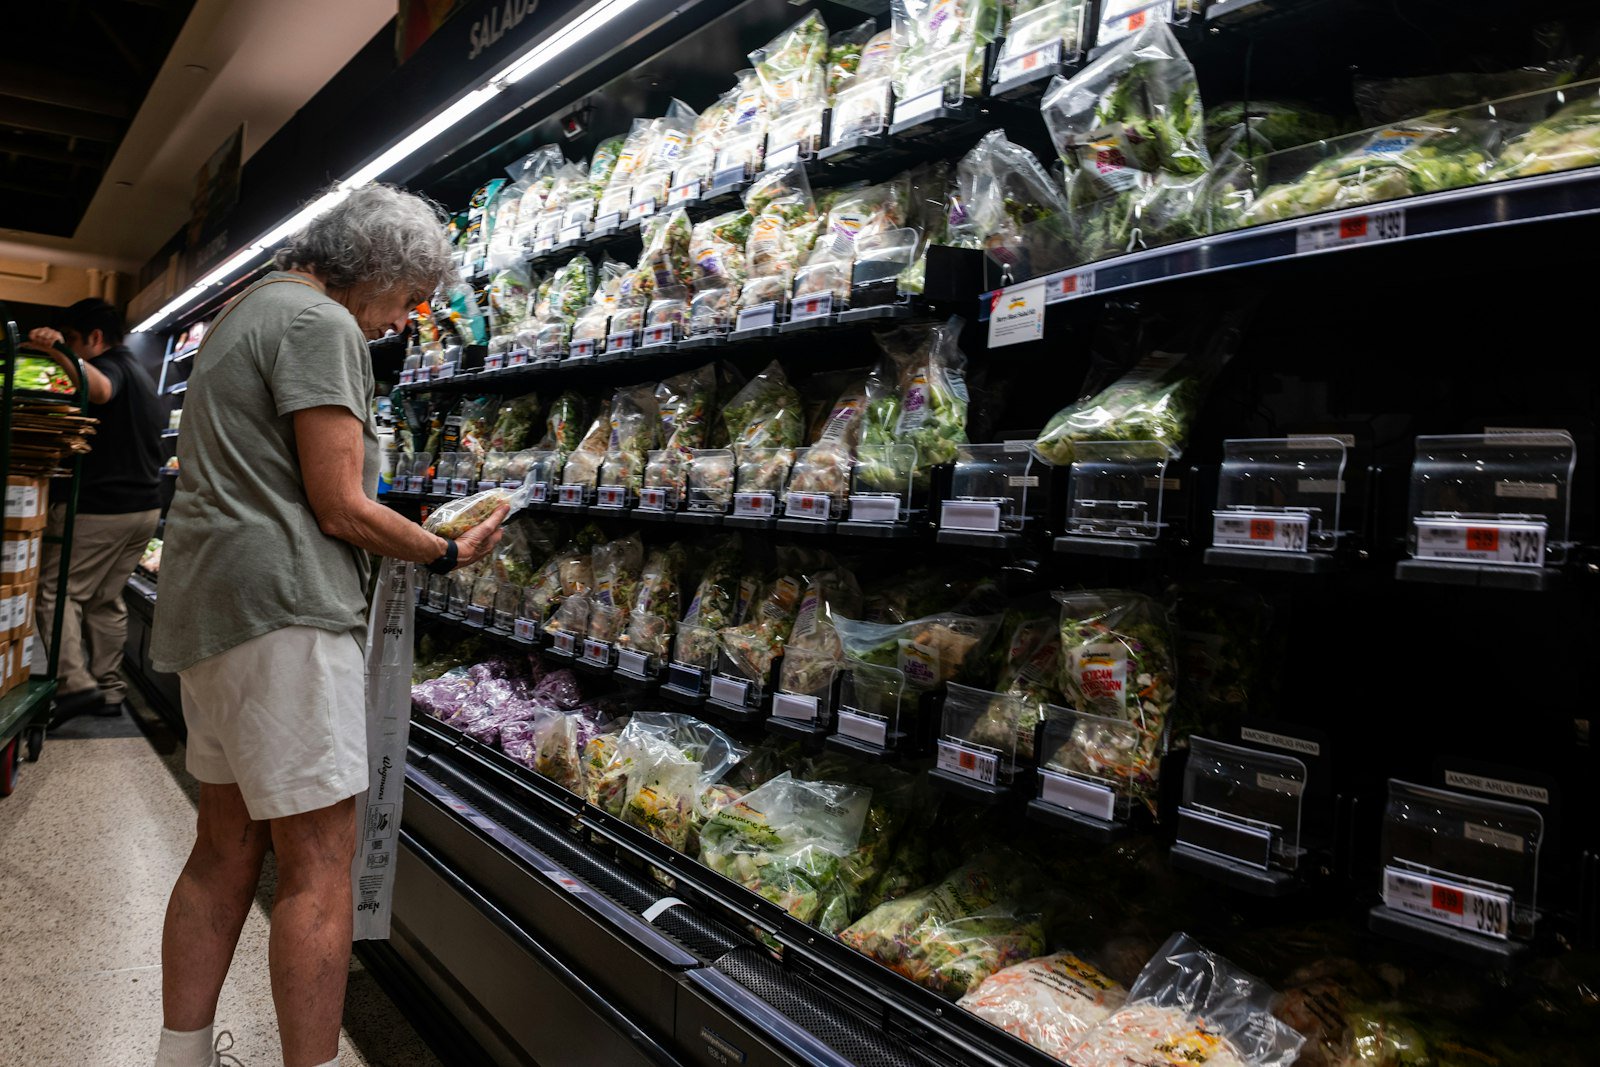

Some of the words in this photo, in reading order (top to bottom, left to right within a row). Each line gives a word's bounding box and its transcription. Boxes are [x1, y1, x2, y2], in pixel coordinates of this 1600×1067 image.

[382, 627, 403, 636] OPEN
[1243, 730, 1270, 742] AMORE
[376, 755, 393, 800] Wegmans
[1446, 773, 1483, 788] AMORE
[1485, 779, 1515, 794] ARUG
[1516, 785, 1547, 801] PARM
[357, 901, 380, 912] OPEN
[1472, 894, 1503, 935] $399
